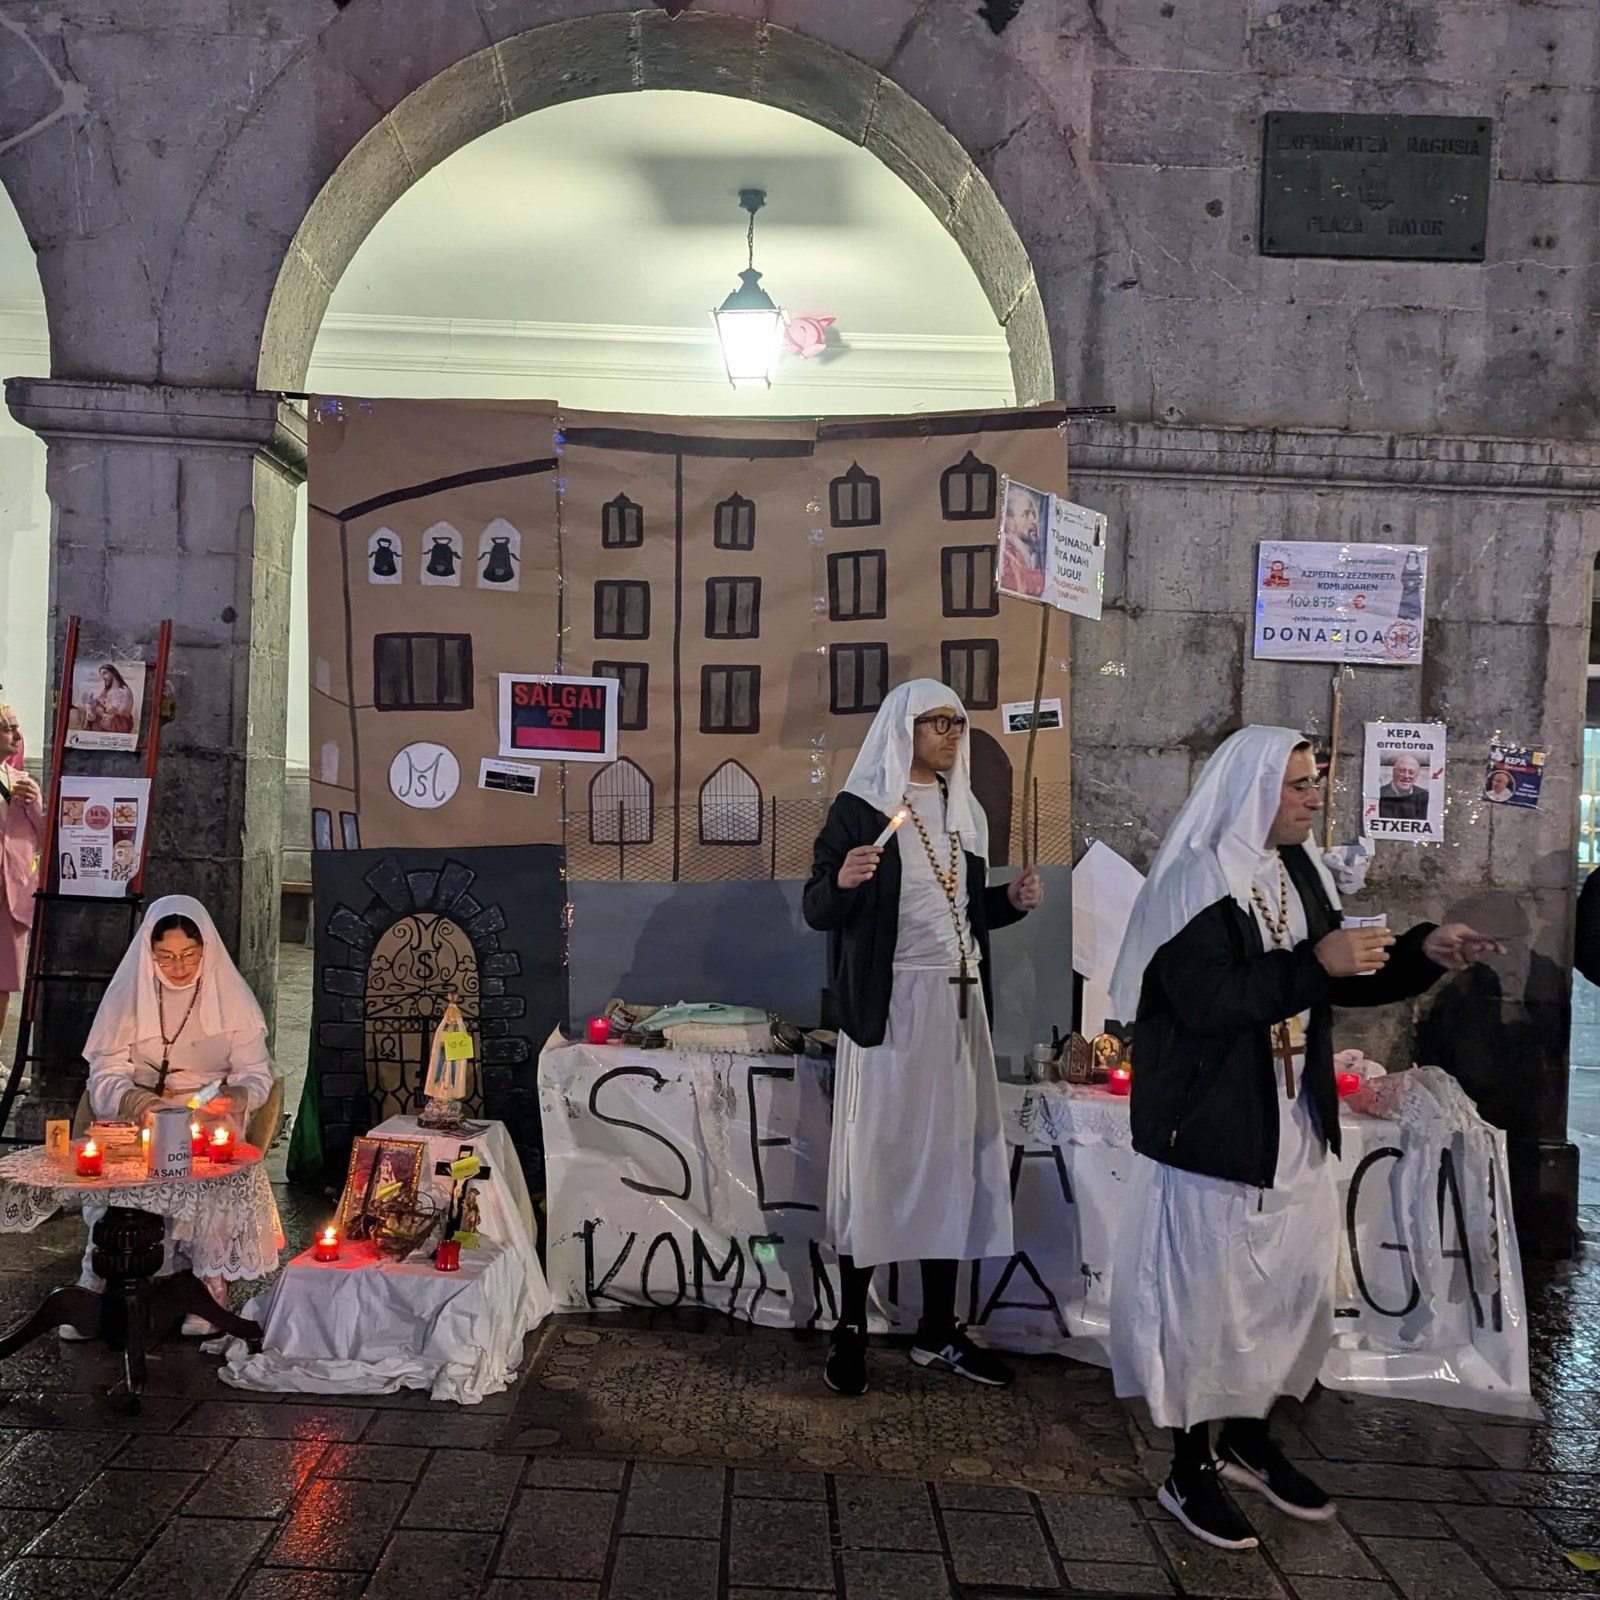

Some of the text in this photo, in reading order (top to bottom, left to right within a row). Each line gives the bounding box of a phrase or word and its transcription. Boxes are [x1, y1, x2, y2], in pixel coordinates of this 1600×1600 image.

[1306, 216, 1364, 233] PLAZA
[1347, 572, 1396, 581] ZEZENKETA
[1352, 594, 1367, 609] €
[1263, 626, 1385, 644] DONAZIOA
[514, 684, 603, 709] SALGAI
[1387, 729, 1421, 739] KEPA
[1376, 741, 1434, 751] erretorea
[1504, 756, 1527, 767] KEPA
[1370, 819, 1433, 834] ETXERA
